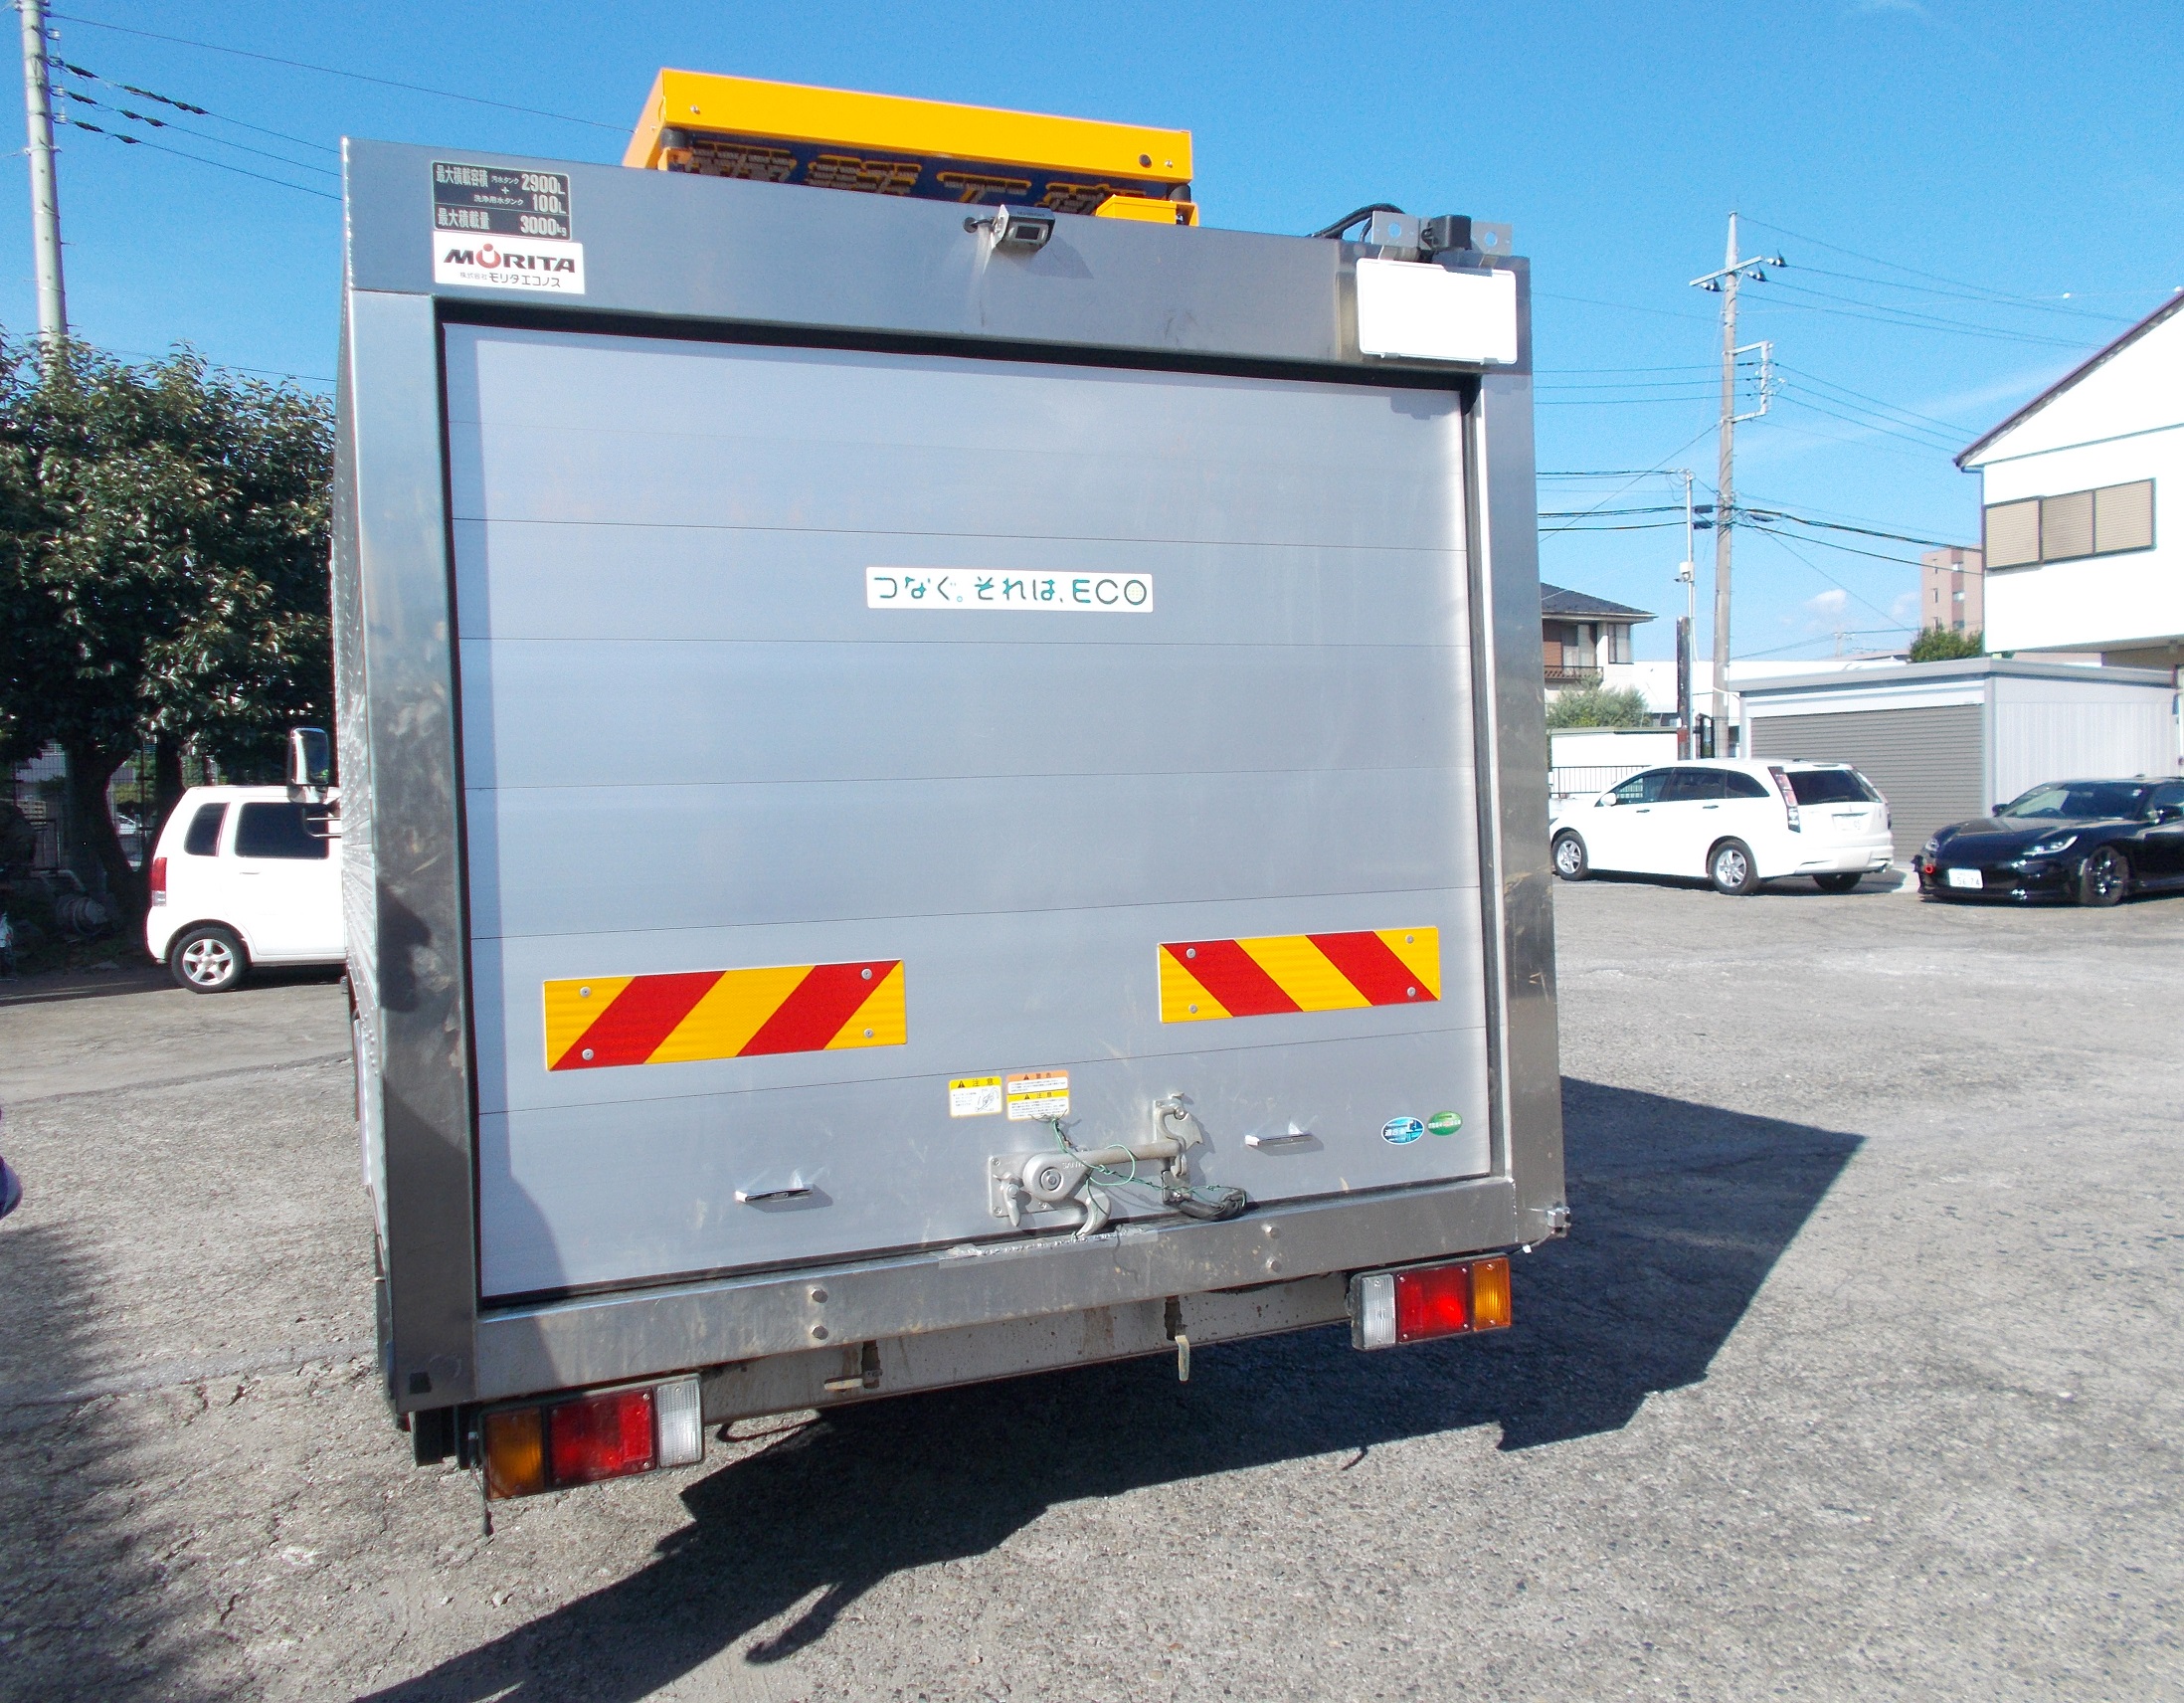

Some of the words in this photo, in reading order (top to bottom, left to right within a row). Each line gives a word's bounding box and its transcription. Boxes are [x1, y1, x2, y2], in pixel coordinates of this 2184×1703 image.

[436, 164, 488, 188] 最大積載容積
[521, 173, 566, 195] 2900L
[532, 194, 567, 215] 100L
[438, 207, 490, 230] 最大積載量
[520, 215, 568, 238] 3000kg
[444, 243, 576, 274] MORITA
